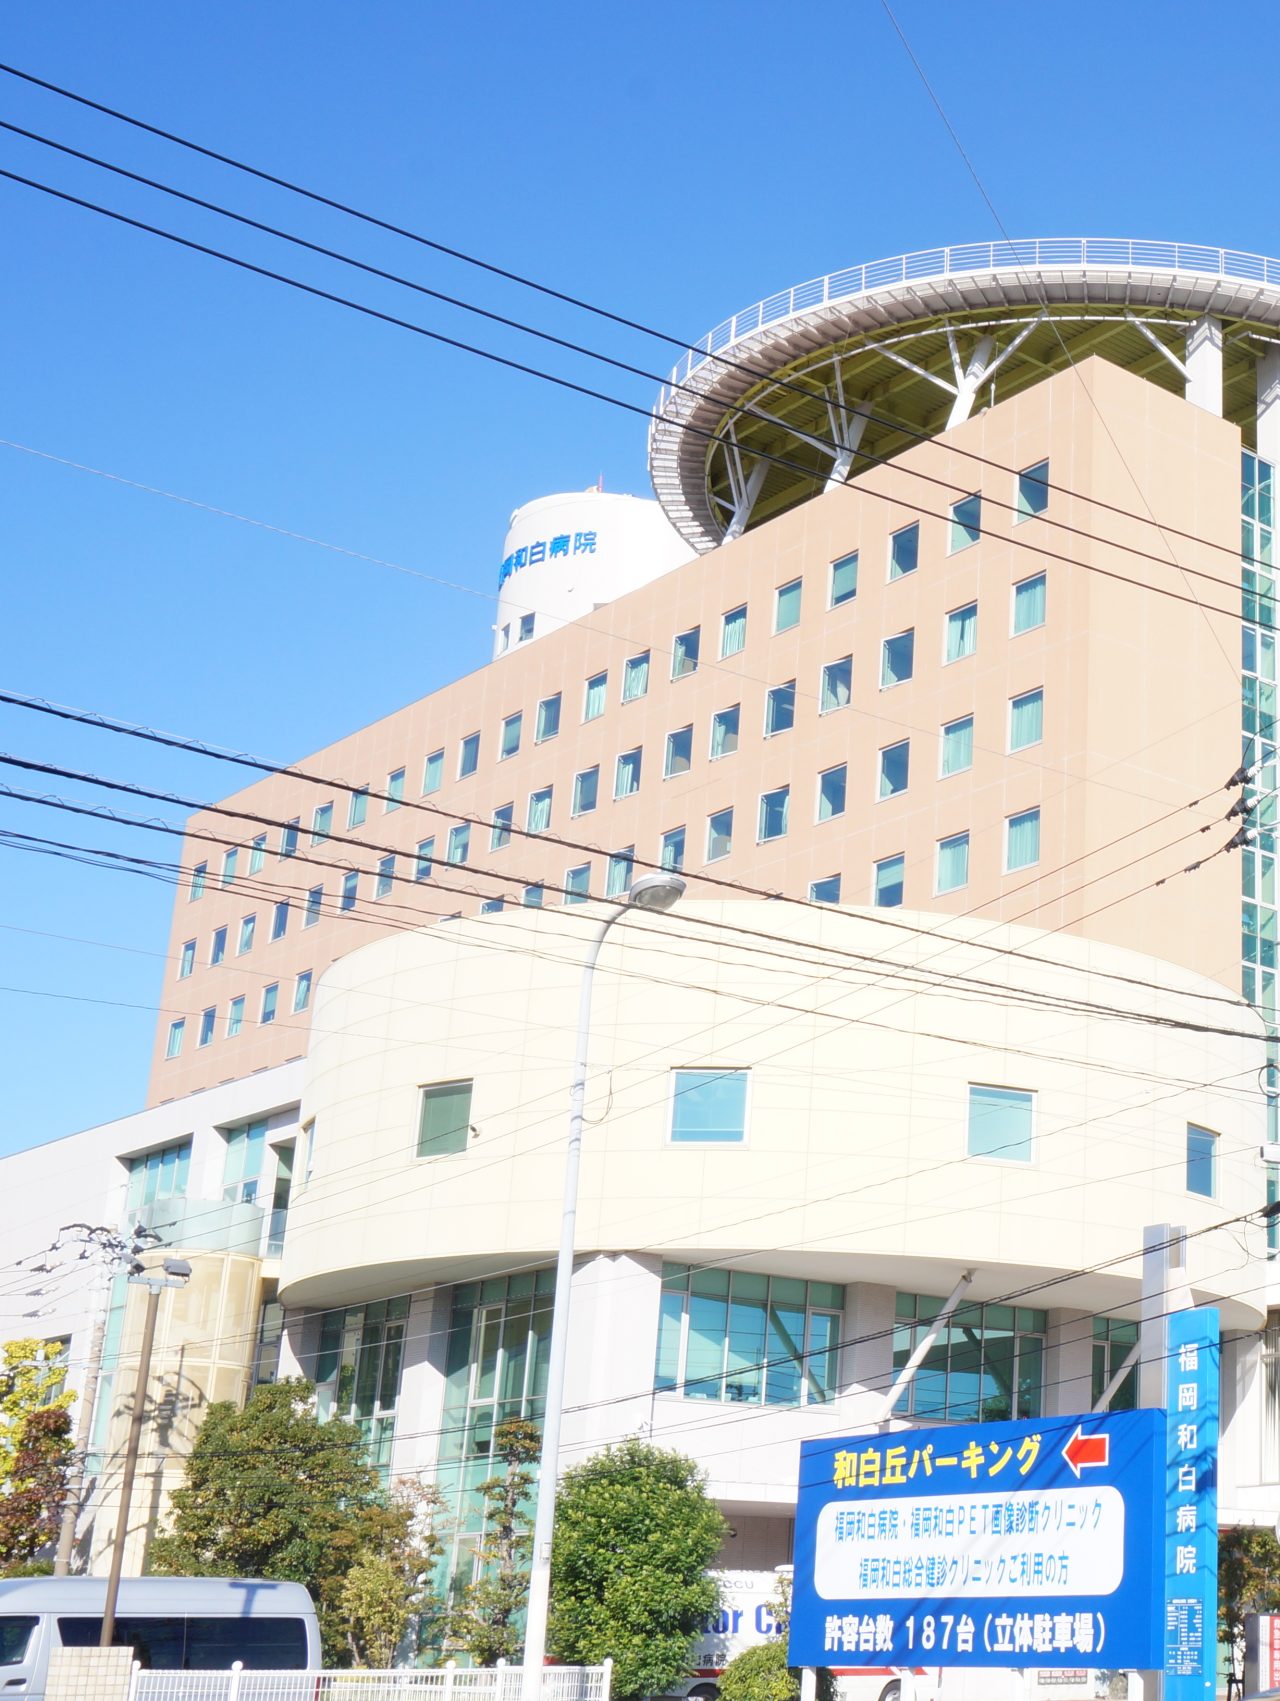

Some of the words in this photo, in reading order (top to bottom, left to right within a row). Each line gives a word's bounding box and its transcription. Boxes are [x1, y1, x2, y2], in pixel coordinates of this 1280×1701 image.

[832, 1433, 1042, 1489] 和白丘パーキング
[1175, 1343, 1199, 1576] 福岡和白病院
[858, 1550, 1070, 1590] 福岡和白総合健診クリニックご利用の方
[824, 1614, 894, 1653] 許容台数
